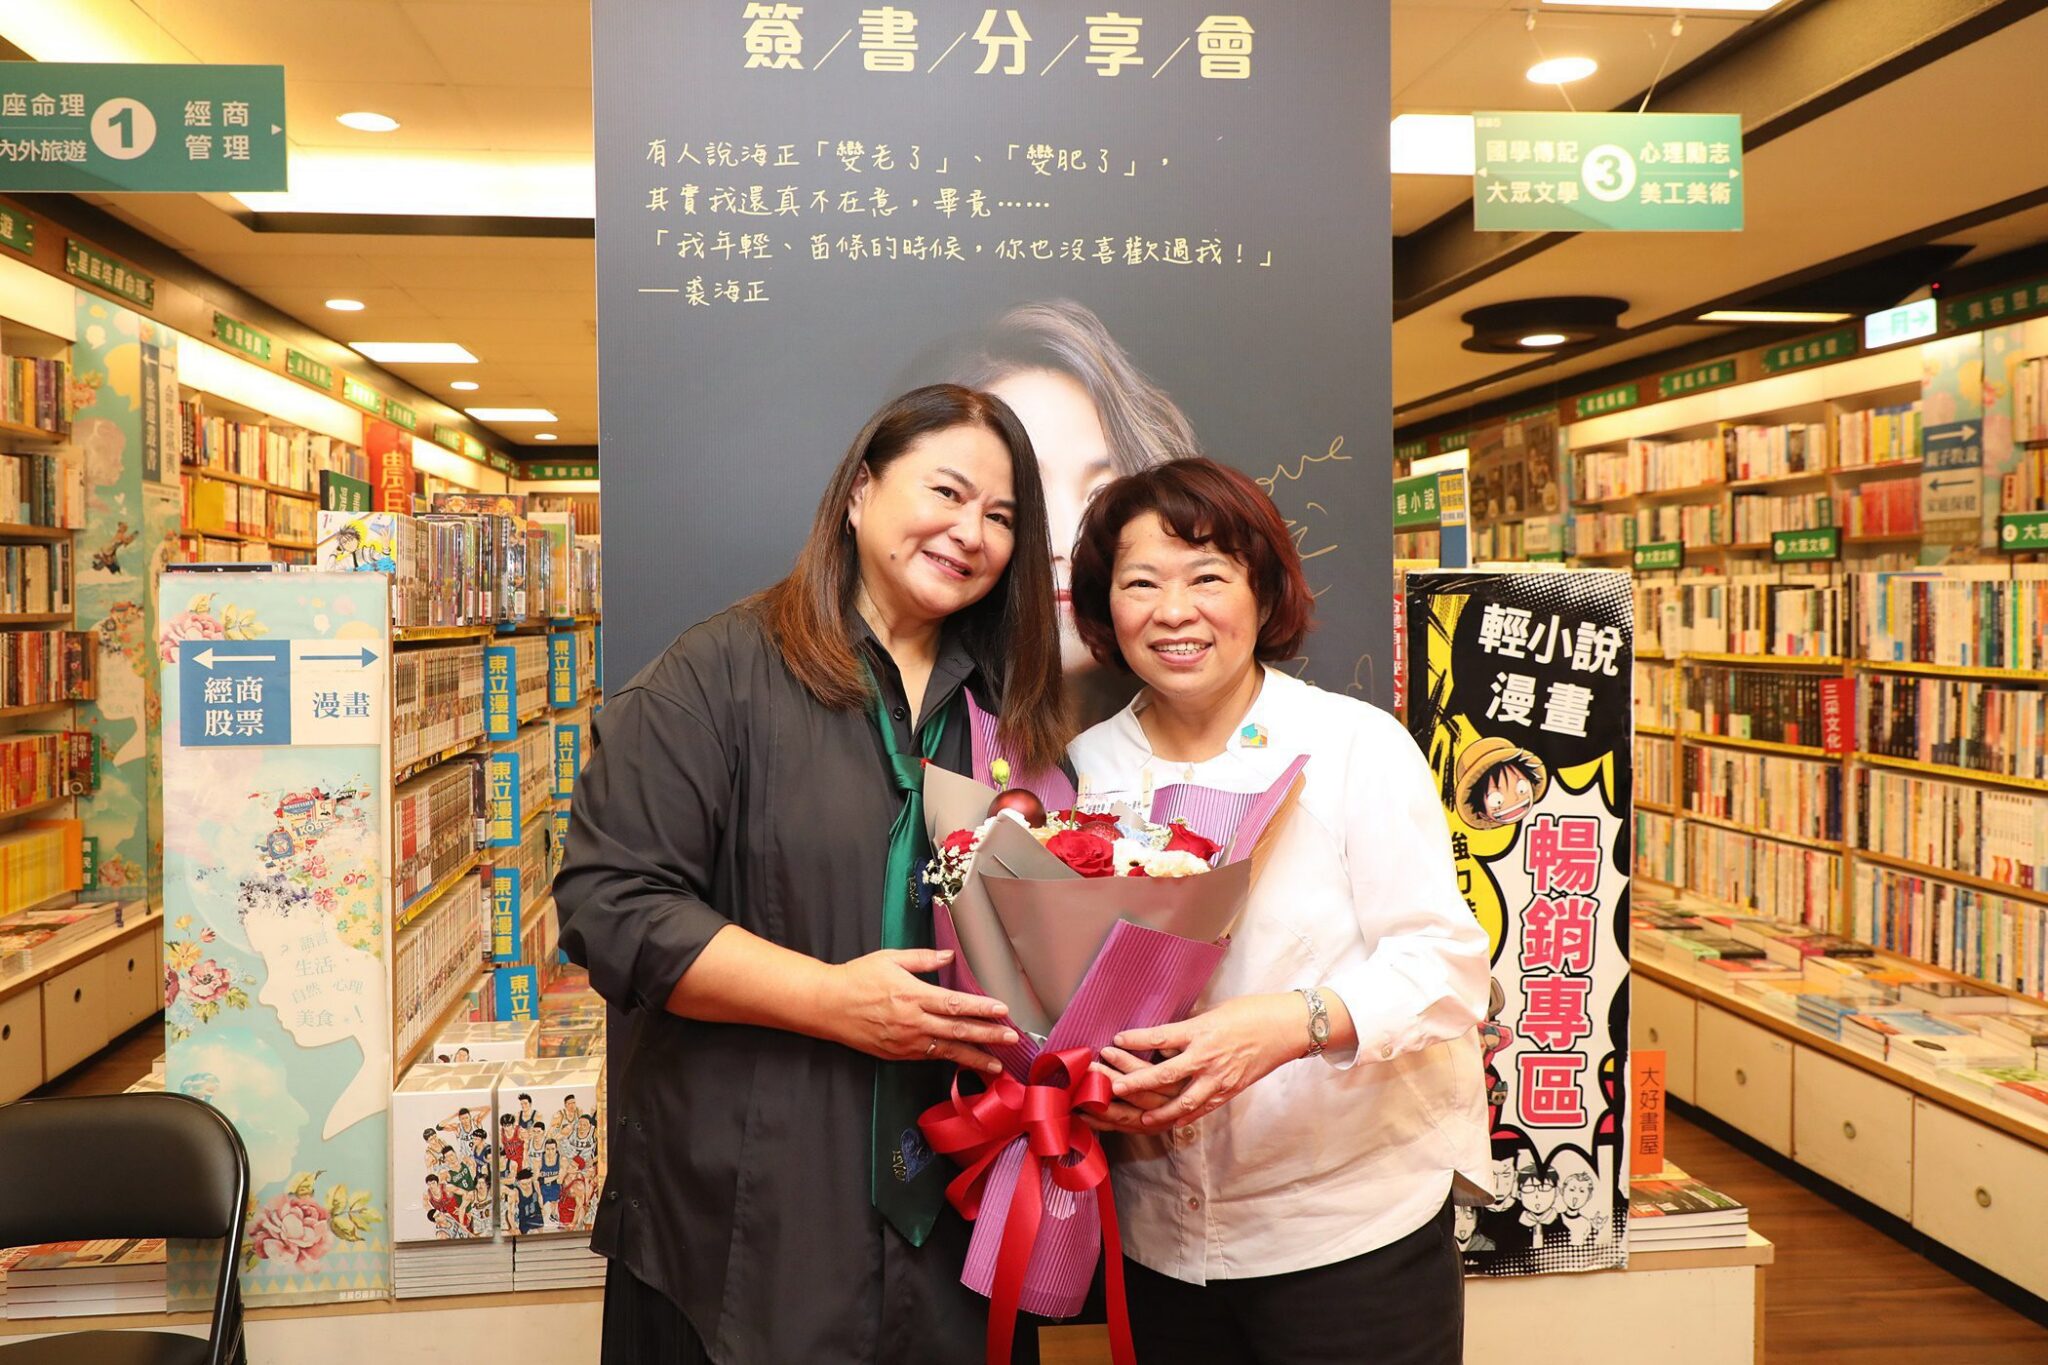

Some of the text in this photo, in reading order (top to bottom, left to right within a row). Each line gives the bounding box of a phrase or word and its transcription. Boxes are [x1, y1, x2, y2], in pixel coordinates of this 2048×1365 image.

[2, 93, 86, 118] 座命理
[184, 101, 250, 128] 經商
[108, 107, 135, 149] 1
[0, 140, 87, 163] 內外旅遊
[185, 135, 251, 161] 管理
[1485, 139, 1580, 164] 國學傳記
[1639, 141, 1731, 165] 心理勵志
[1594, 154, 1623, 192] 3
[1486, 181, 1580, 205] 大眾文學
[1639, 181, 1732, 205] 美工美術
[1478, 602, 1624, 678] 輕小說
[204, 676, 264, 705] 經商
[489, 655, 510, 734] 東立漫畫
[1484, 672, 1594, 738] 漫畫
[313, 691, 371, 720] 漫畫
[204, 708, 264, 737] 股票
[295, 954, 336, 978] 生活
[1518, 815, 1601, 1128] 暢銷專區
[1639, 1066, 1661, 1156] 大好書屋
